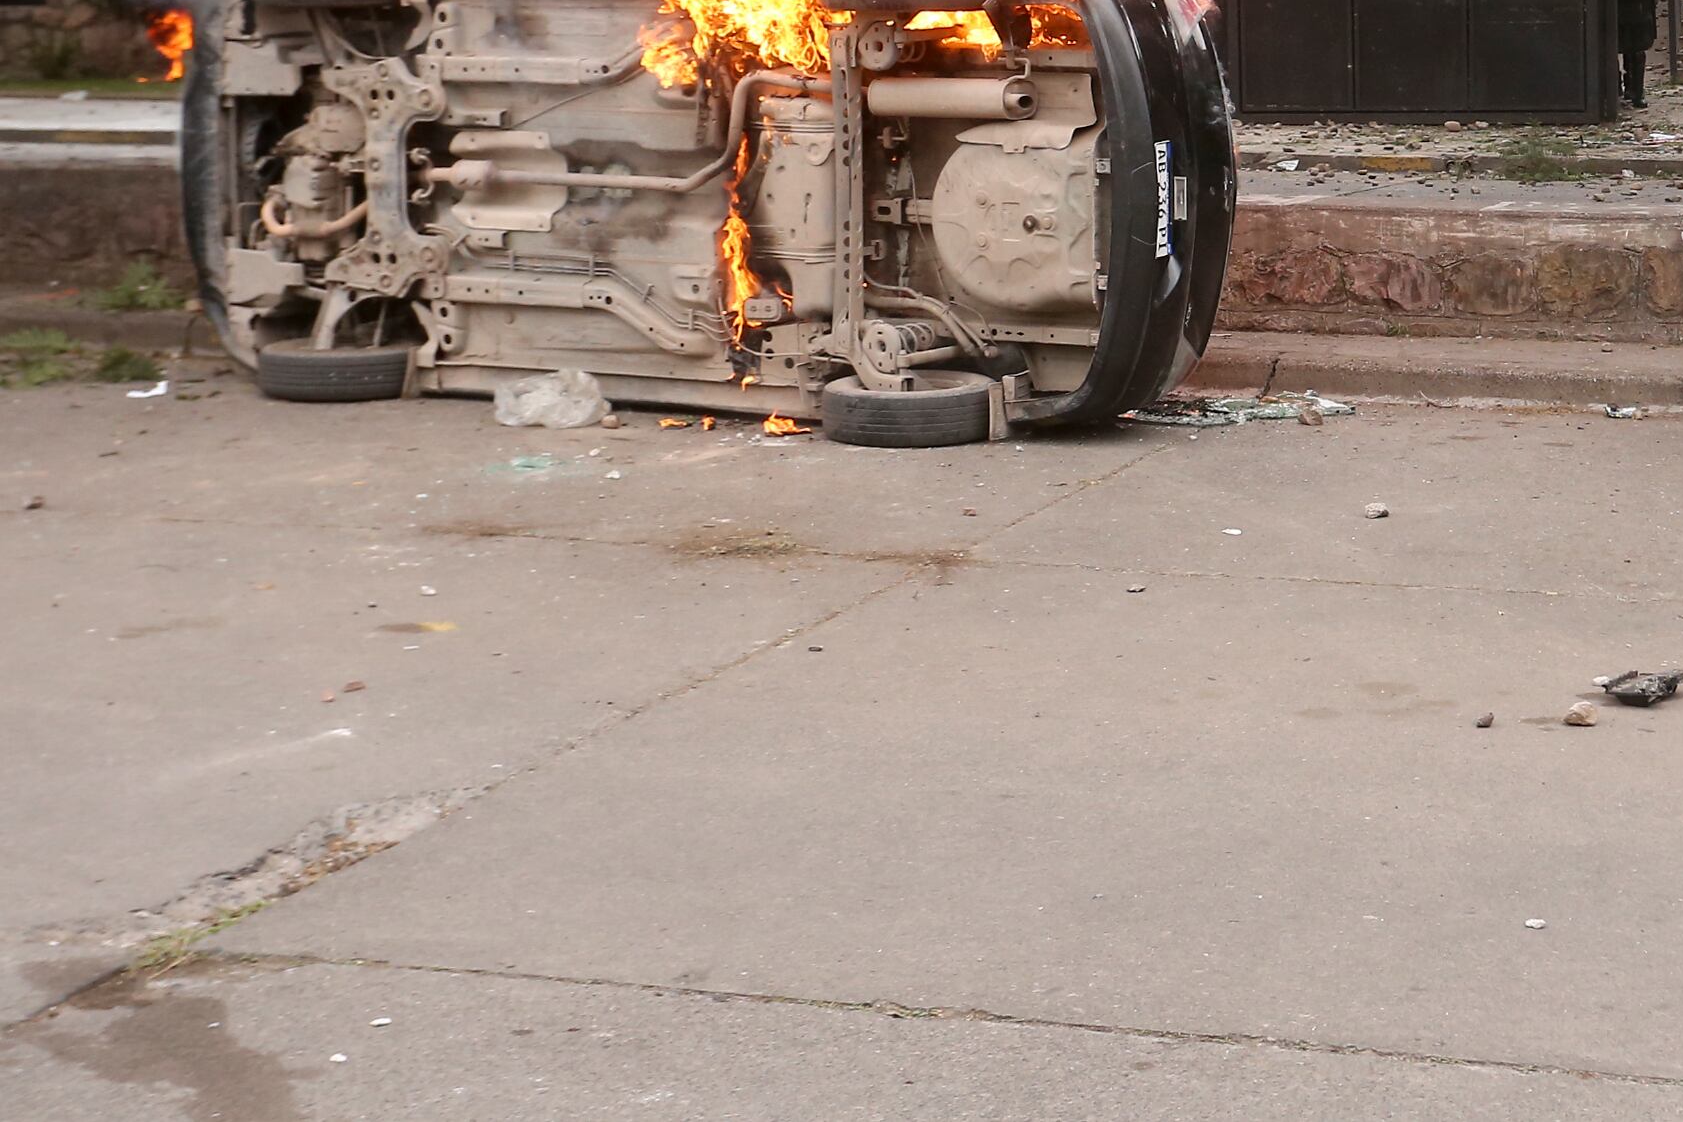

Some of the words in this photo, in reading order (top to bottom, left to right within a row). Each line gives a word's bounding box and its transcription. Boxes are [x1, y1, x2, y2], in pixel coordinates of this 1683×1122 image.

[1157, 149, 1167, 173] AB
[1157, 181, 1168, 219] 236
[1158, 226, 1167, 251] PI
